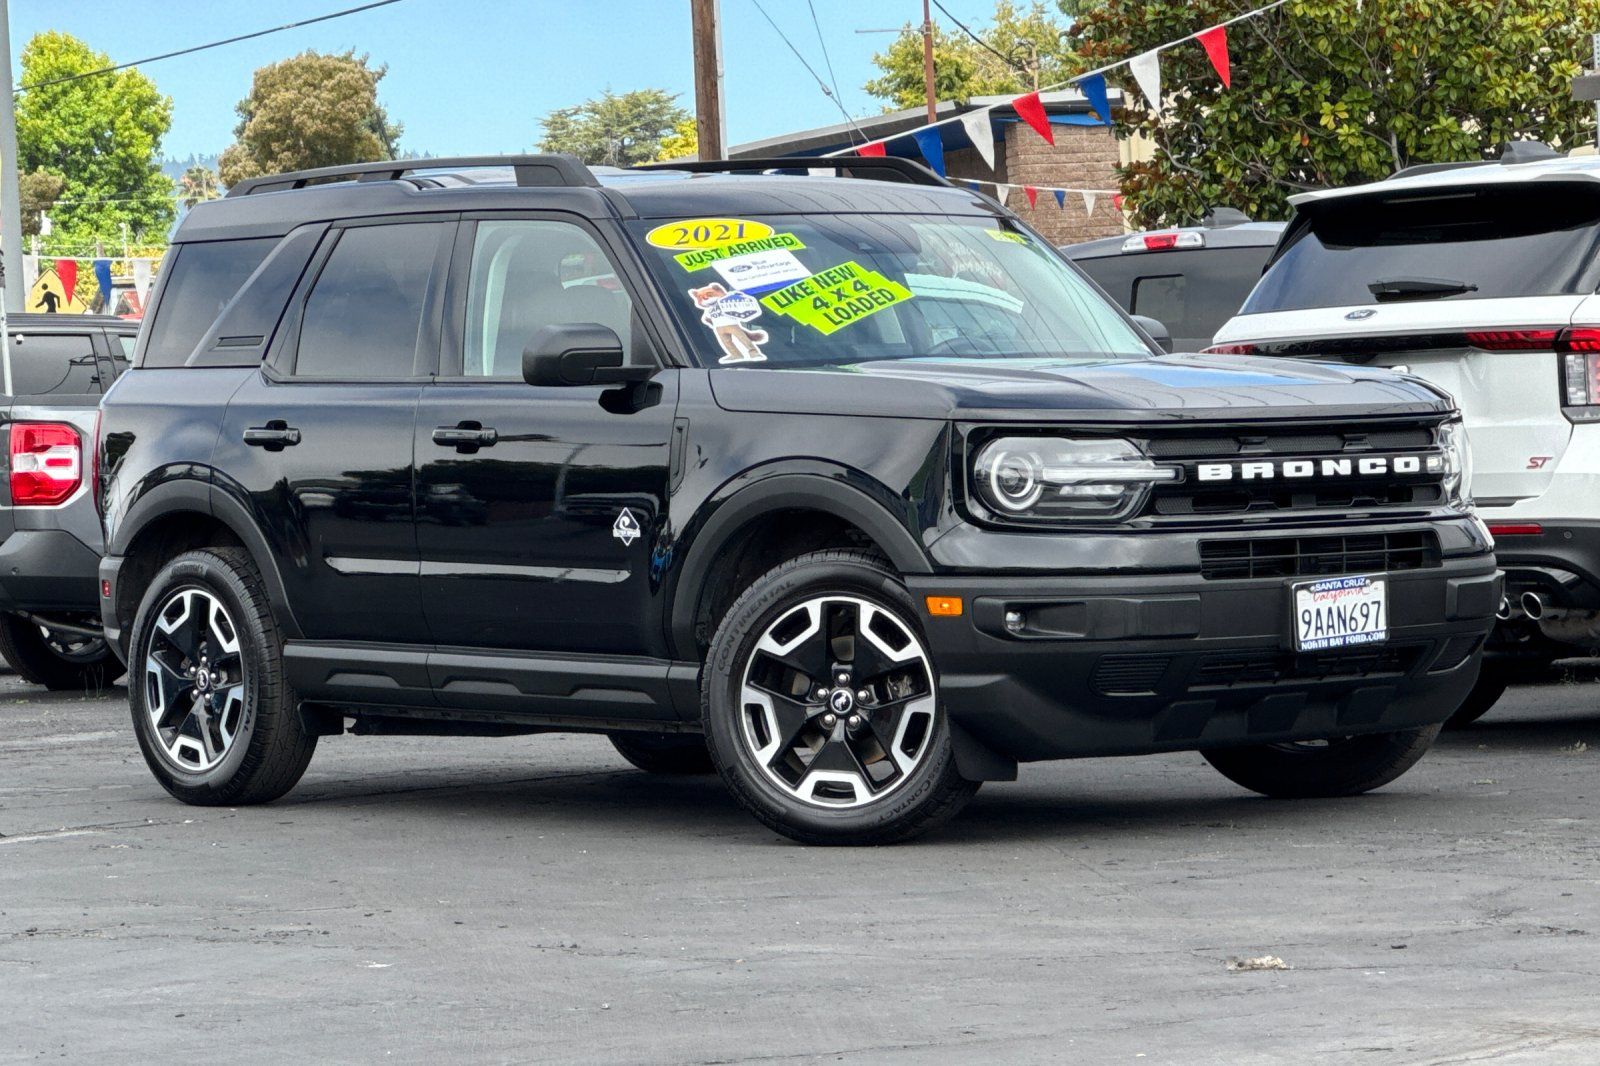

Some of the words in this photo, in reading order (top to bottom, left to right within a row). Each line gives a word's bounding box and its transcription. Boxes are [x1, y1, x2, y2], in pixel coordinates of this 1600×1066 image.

[673, 223, 748, 245] 2021
[684, 248, 725, 267] JUST
[728, 236, 796, 256] ARRIVED
[770, 281, 814, 308] LIKE
[815, 265, 857, 289] NEW
[812, 295, 831, 310] 4
[852, 279, 871, 293] 4
[822, 288, 897, 325] LOADED
[1197, 456, 1420, 481] BRONCO
[1526, 456, 1553, 469] ST
[1312, 587, 1370, 603] California
[1315, 580, 1343, 591] SANTA
[1344, 577, 1365, 588] CRUZ
[1301, 600, 1381, 639] 9AAN697
[1301, 641, 1328, 650] NORTH
[1330, 637, 1344, 646] BAY
[1346, 631, 1386, 645] FORD.COM
